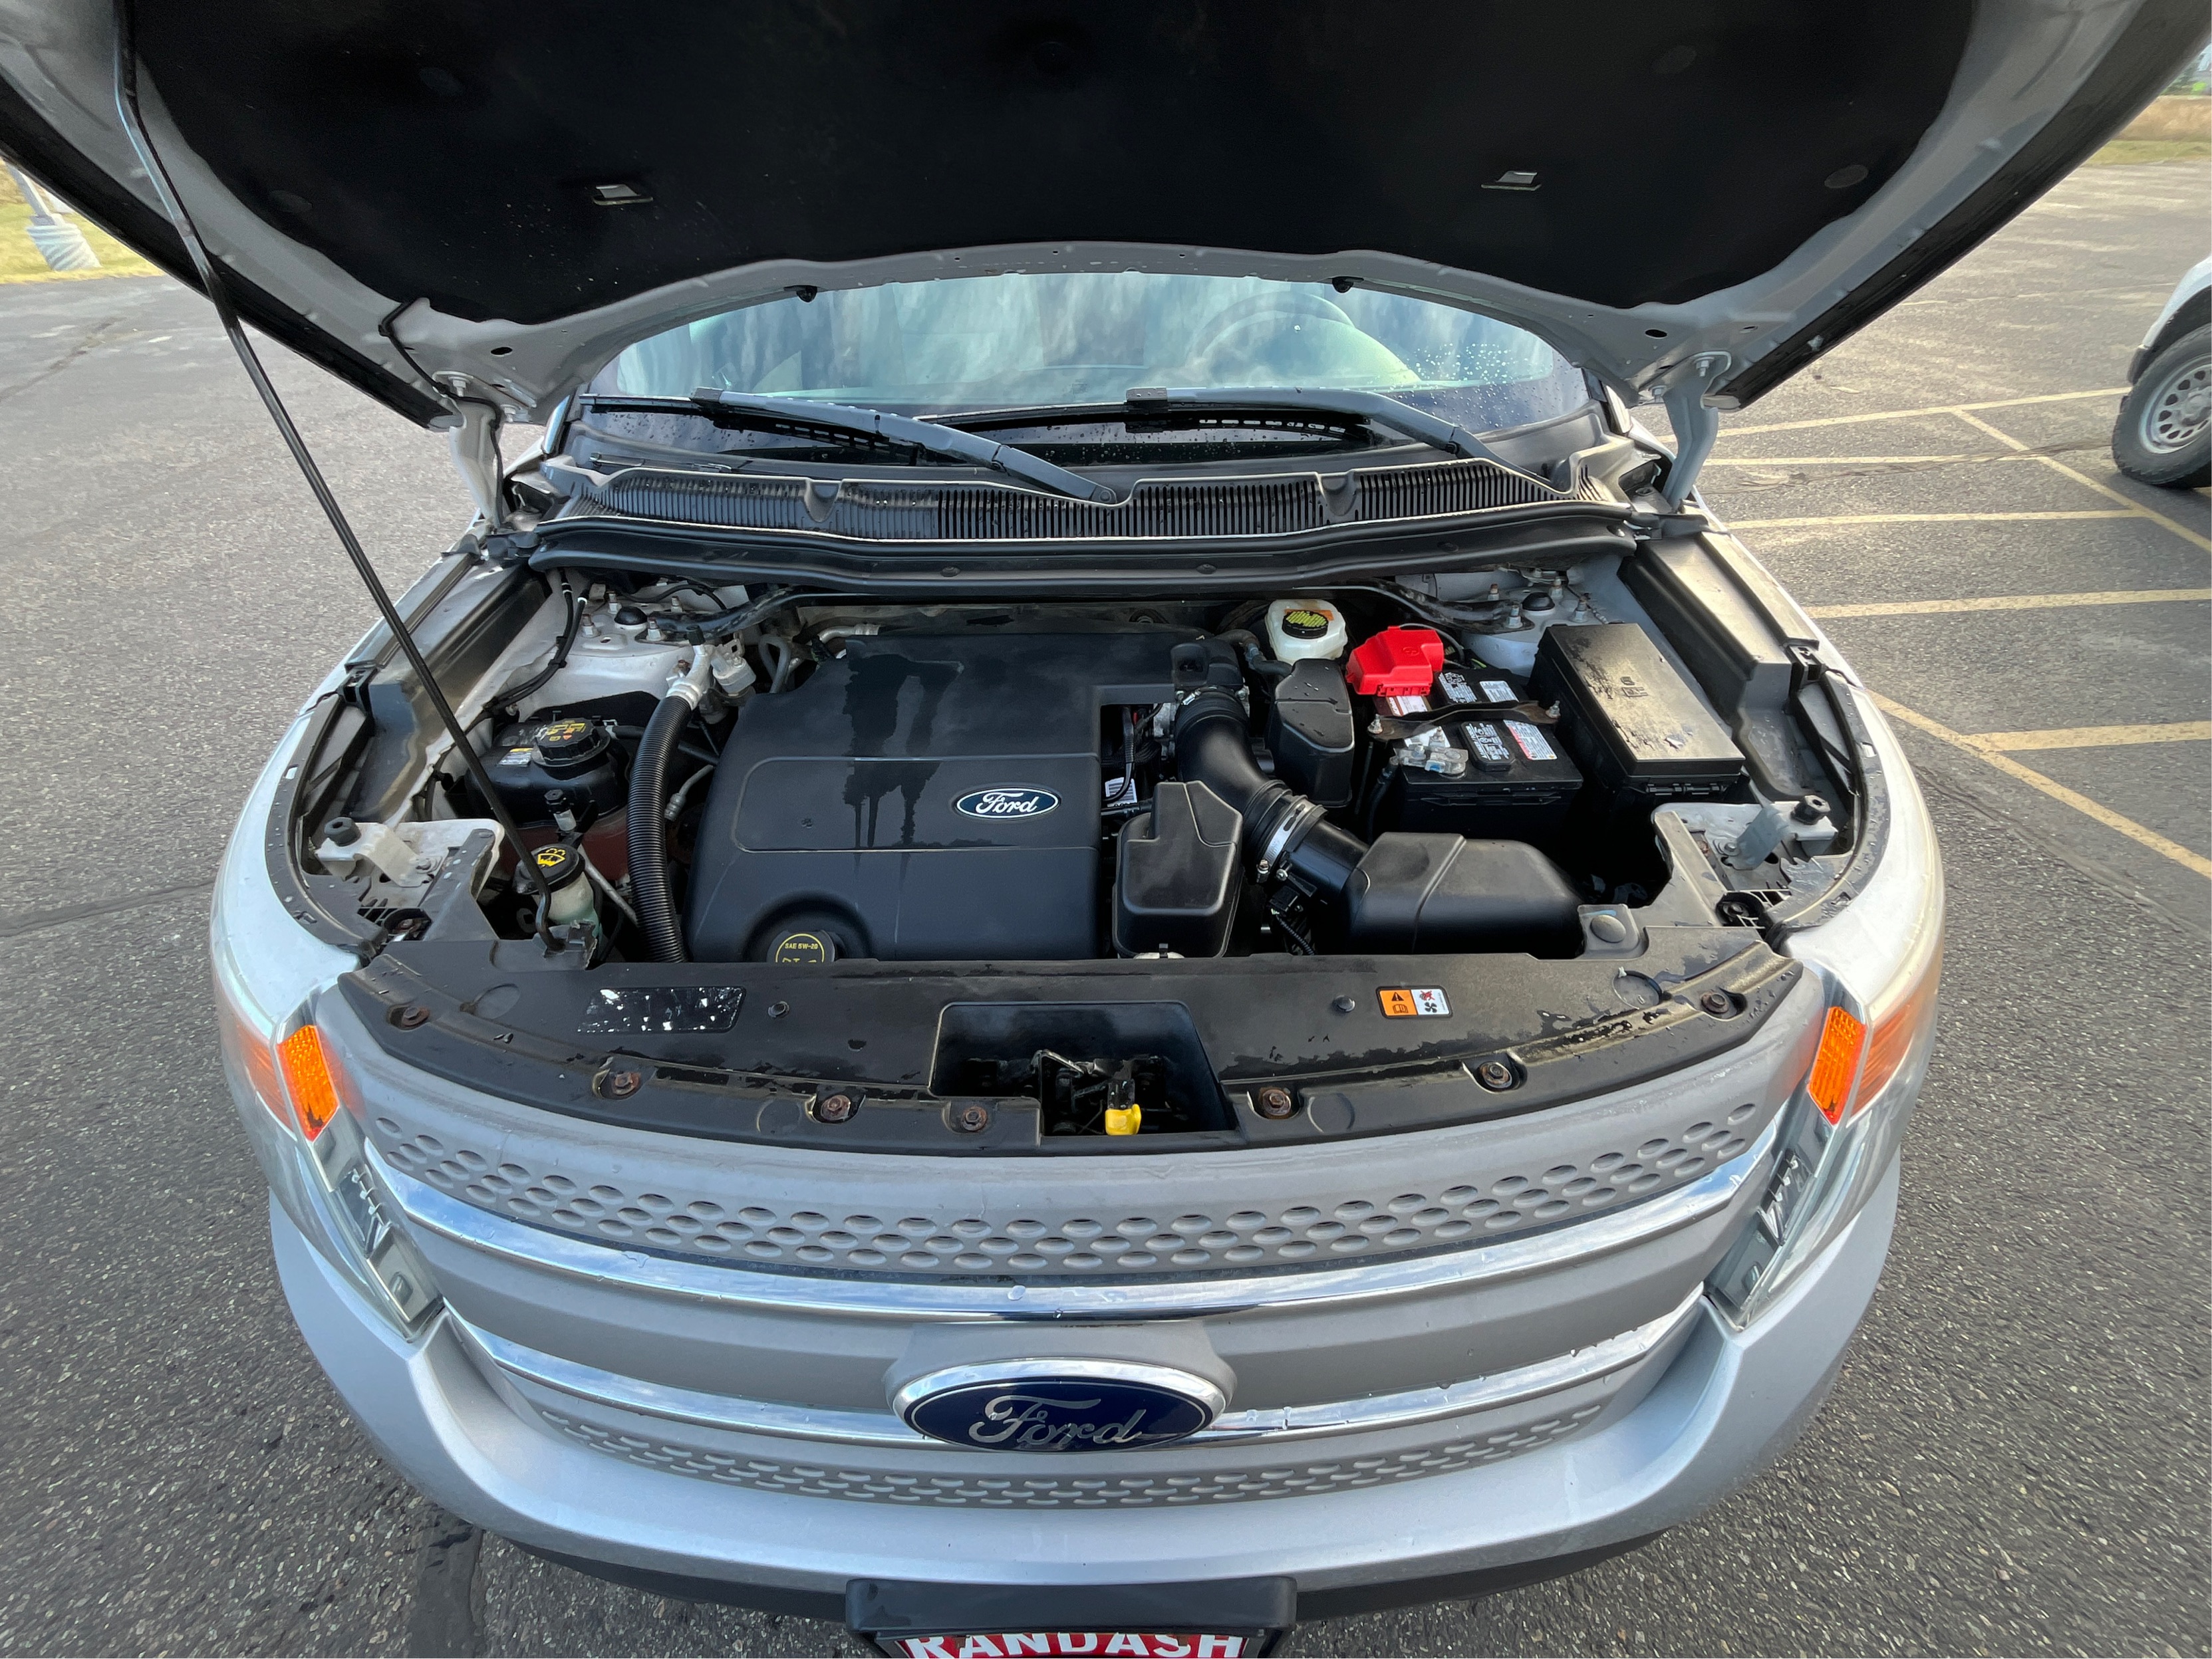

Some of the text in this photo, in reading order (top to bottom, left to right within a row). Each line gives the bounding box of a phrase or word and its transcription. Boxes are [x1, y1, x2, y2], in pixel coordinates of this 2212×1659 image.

[976, 792, 1039, 813] Ford
[969, 1395, 1146, 1445] Ford
[905, 1632, 1243, 1658] RANDASH
